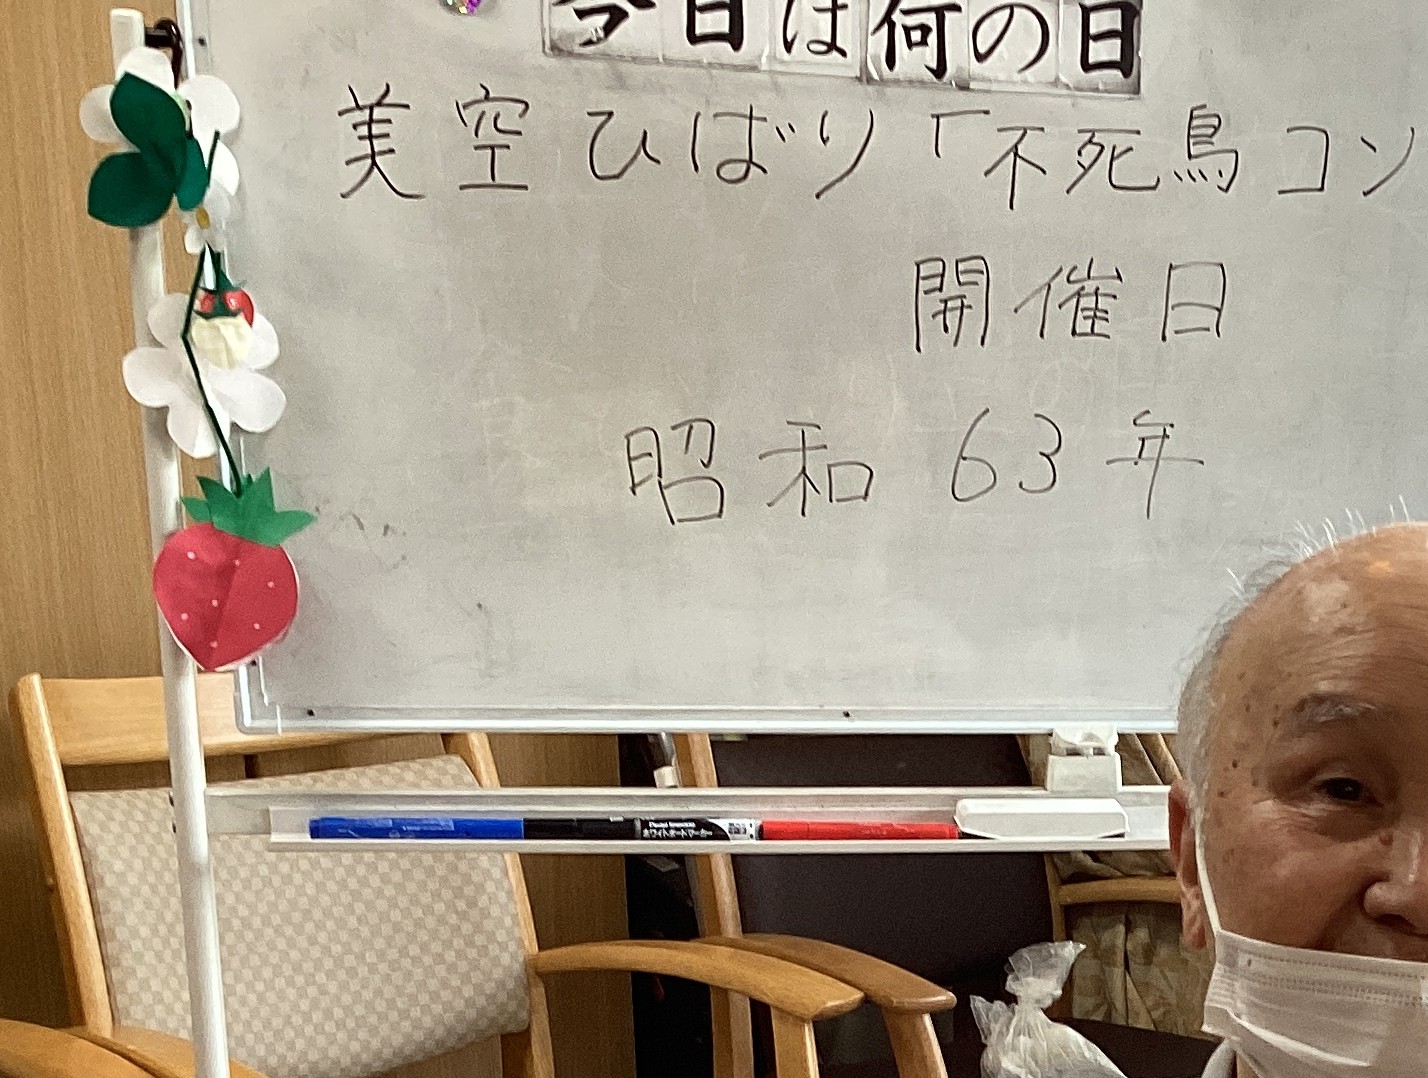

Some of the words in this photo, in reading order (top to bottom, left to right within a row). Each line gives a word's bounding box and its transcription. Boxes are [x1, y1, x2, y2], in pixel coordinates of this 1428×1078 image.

[914, 254, 1227, 354] 開催日
[624, 408, 1205, 526] 昭和63年
